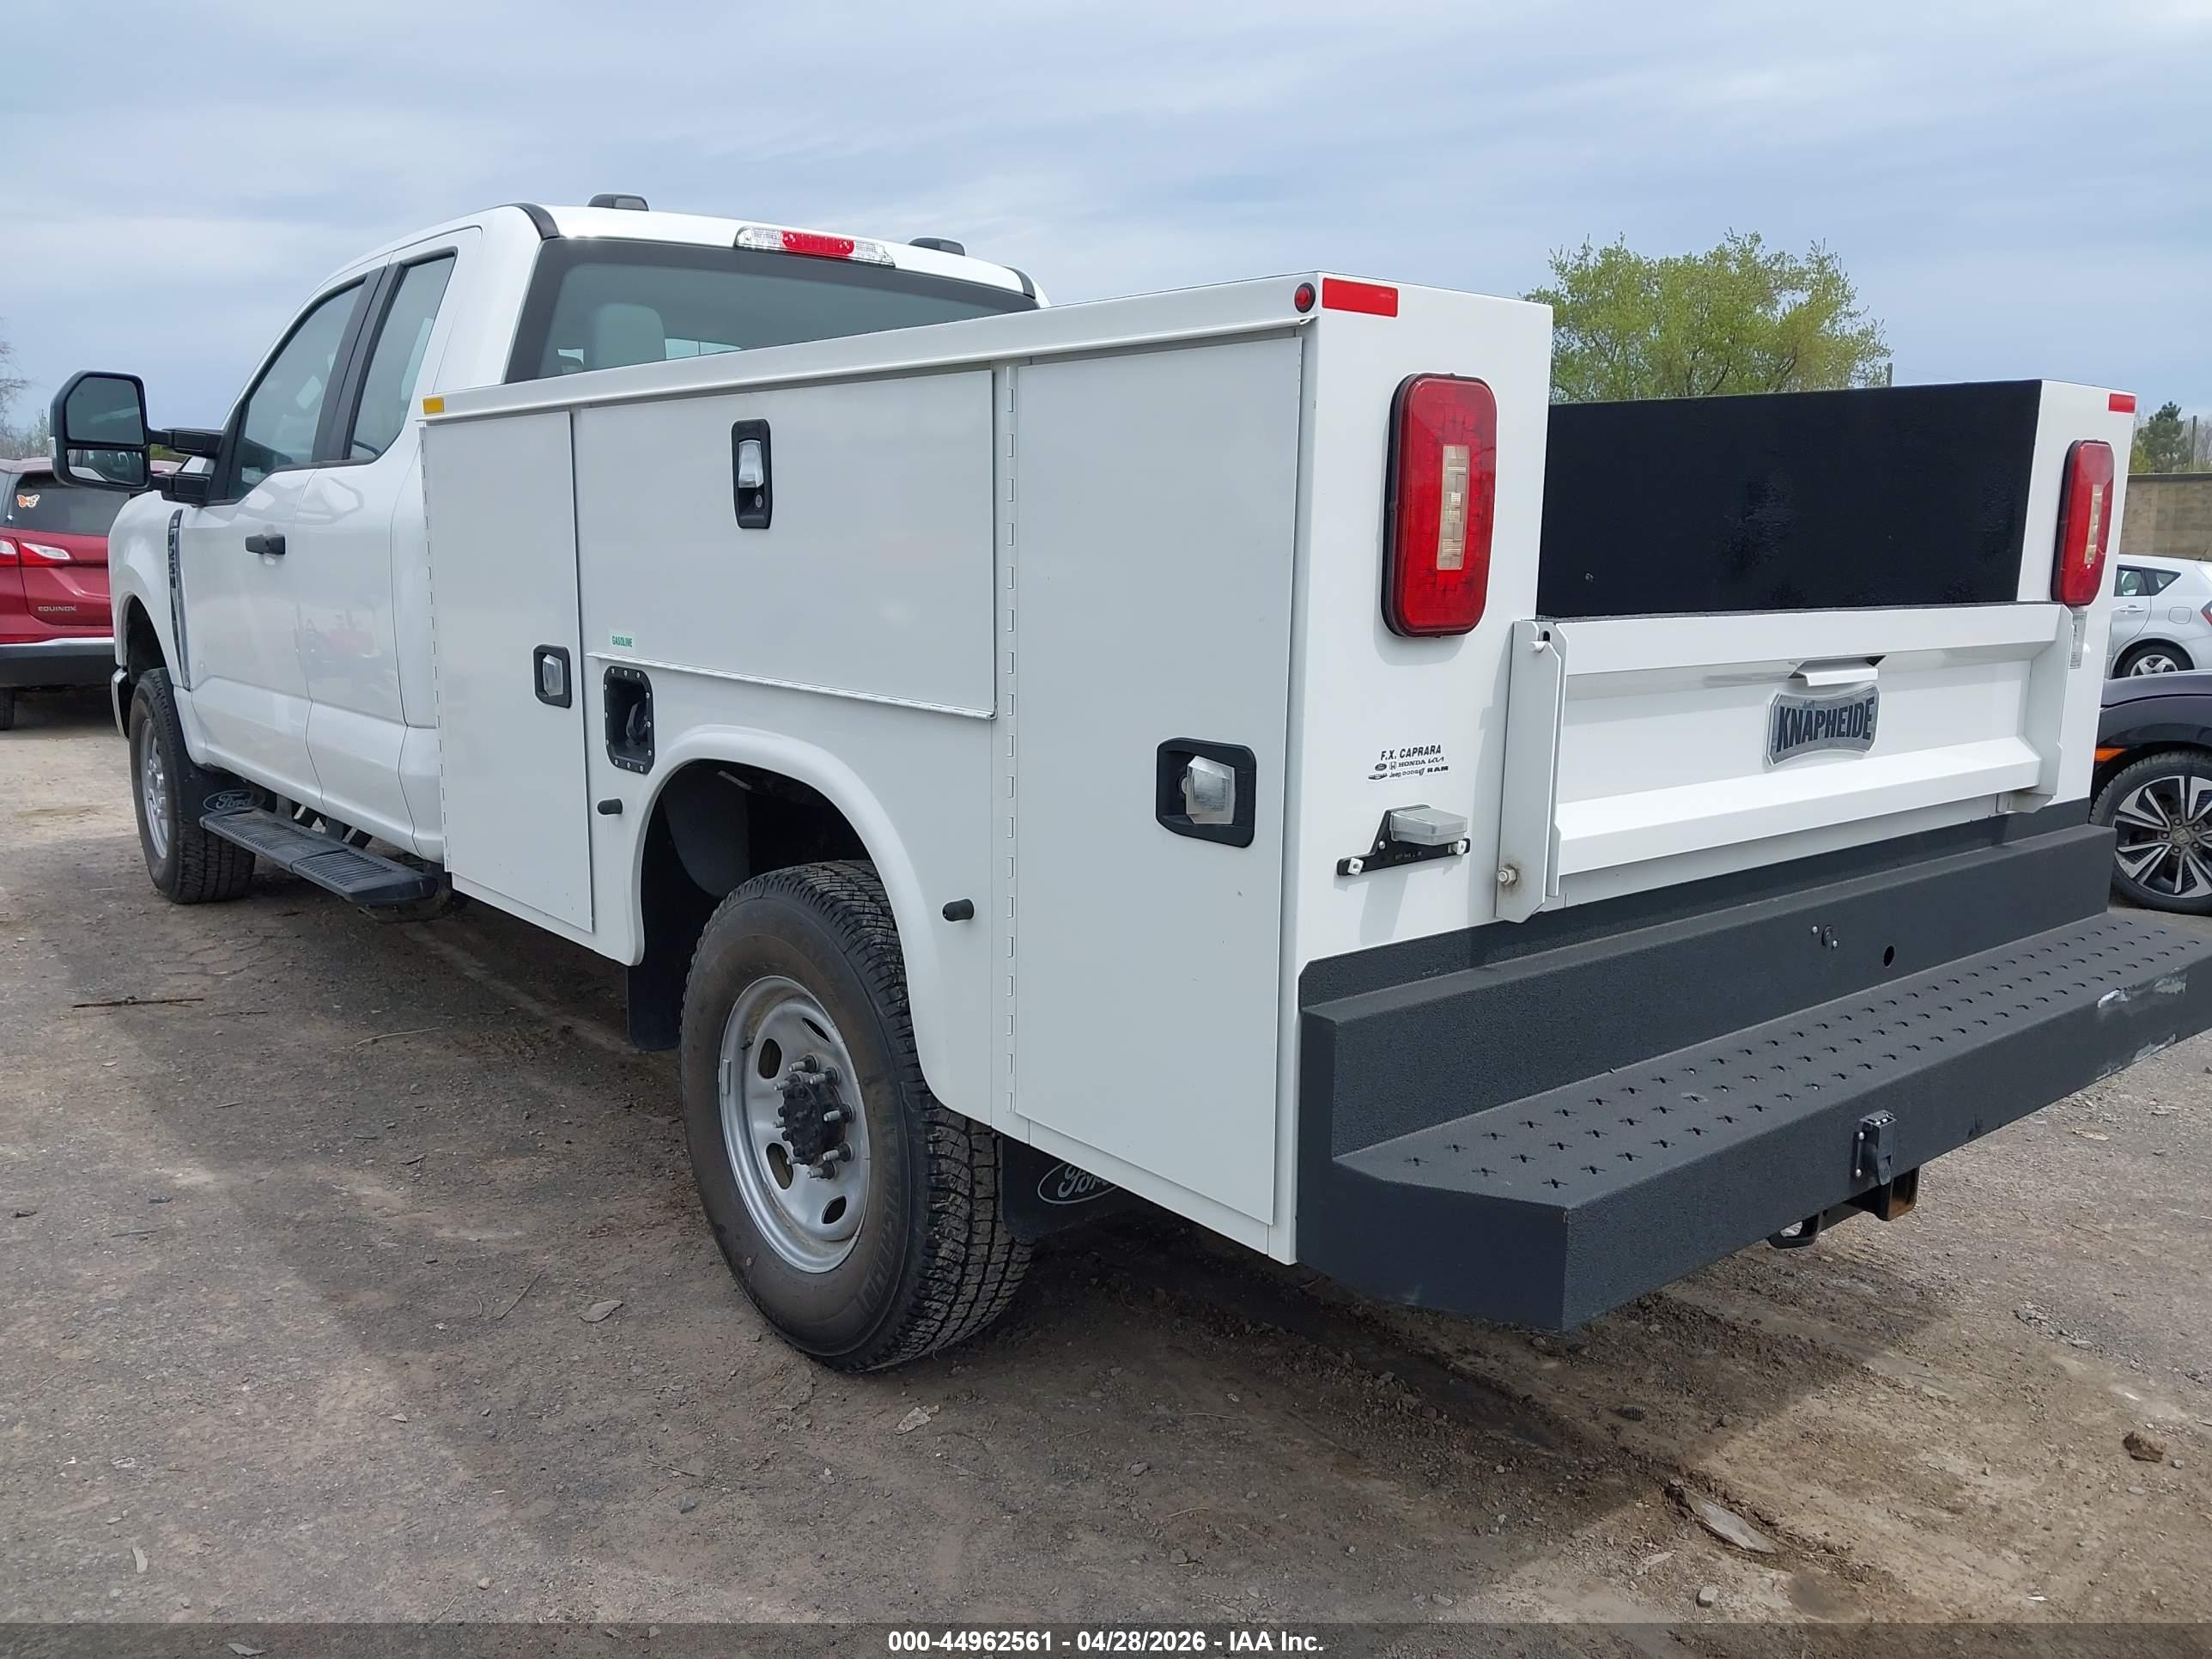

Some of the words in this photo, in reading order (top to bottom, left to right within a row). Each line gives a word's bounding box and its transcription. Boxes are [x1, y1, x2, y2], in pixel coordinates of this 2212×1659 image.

[612, 635, 632, 647] GASOLINE
[1777, 697, 1875, 753] KNAPHEIDE
[1381, 750, 1397, 761] F.X.
[1400, 744, 1441, 758] CAPRARA
